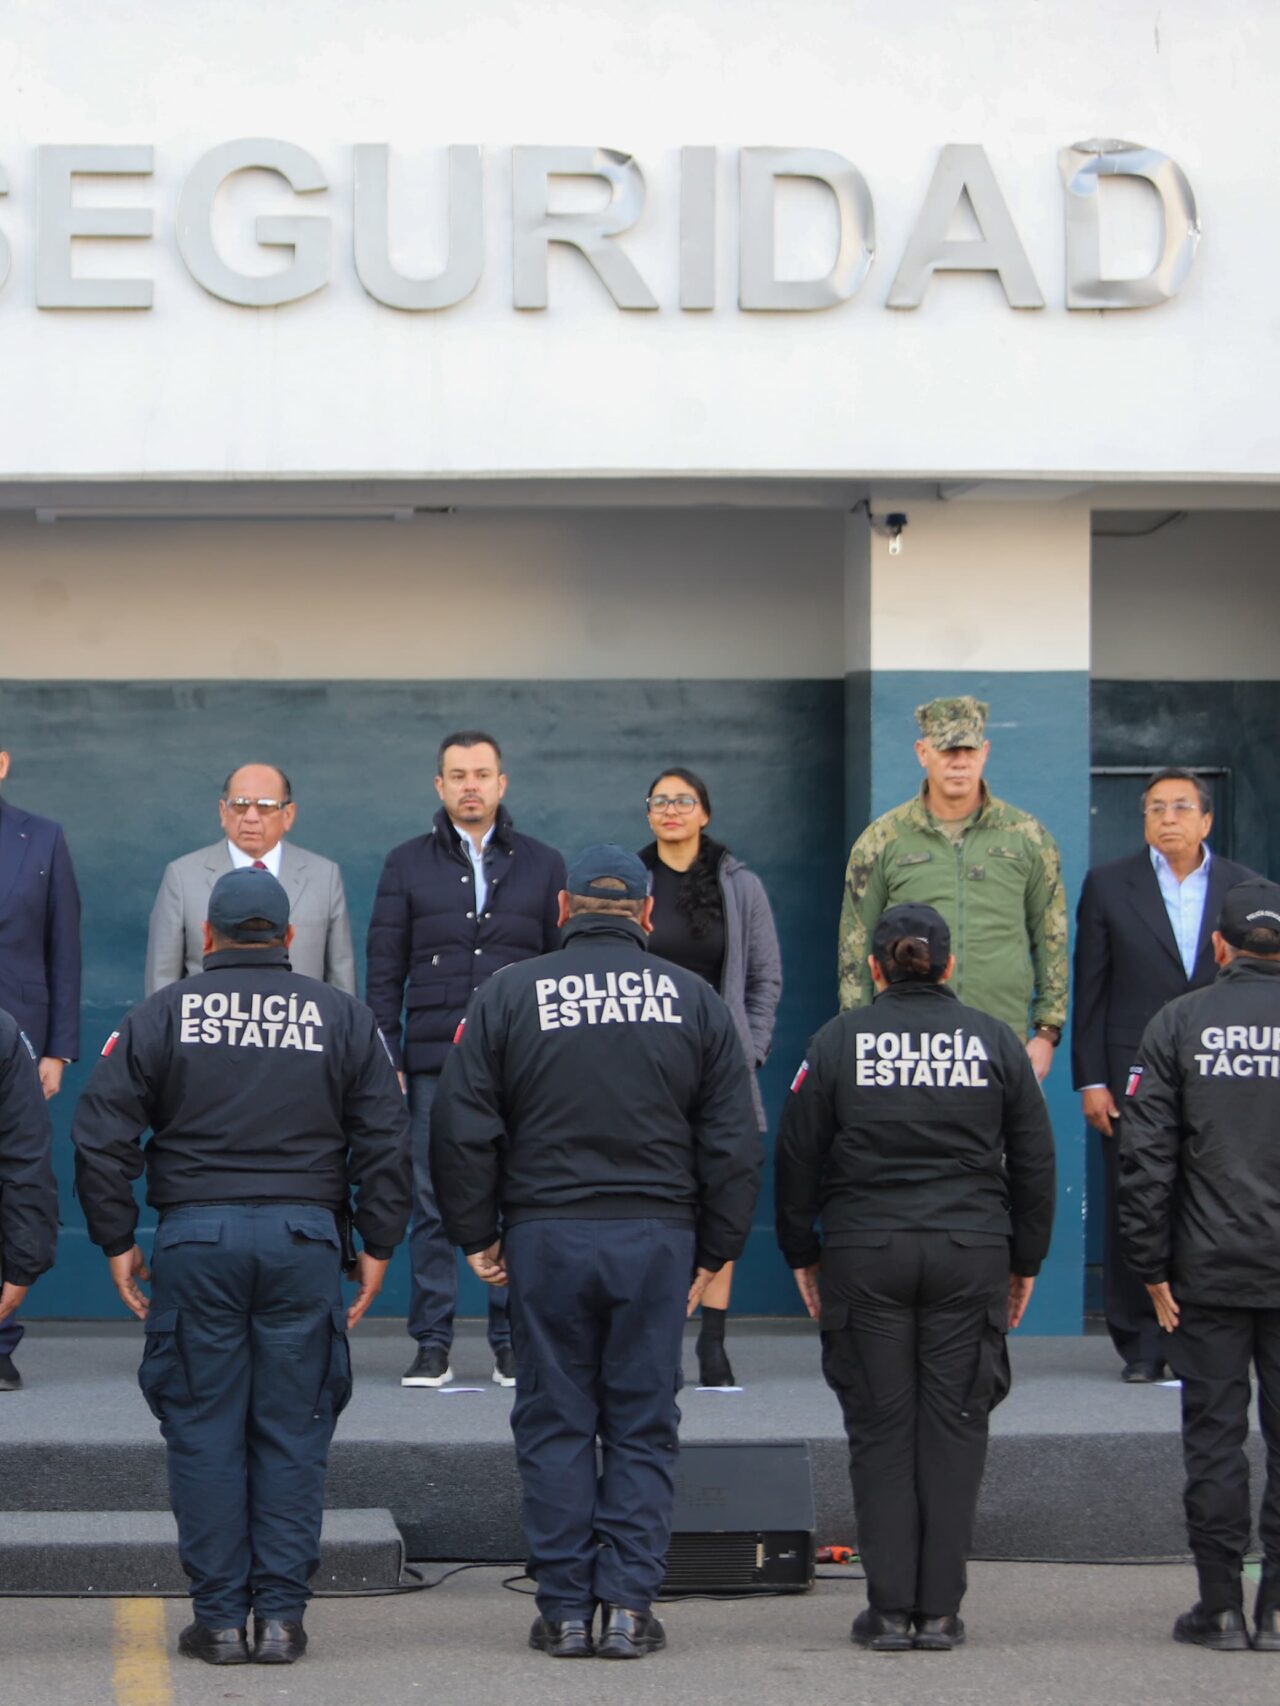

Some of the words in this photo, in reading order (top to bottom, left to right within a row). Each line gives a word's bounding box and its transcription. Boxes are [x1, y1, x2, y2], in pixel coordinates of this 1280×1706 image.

[536, 968, 680, 1005] POLICÍA
[181, 992, 324, 1026] POLICÍA
[538, 996, 683, 1031] ESTATAL
[180, 1018, 324, 1052] ESTATAL
[855, 1028, 989, 1060] POLICÍA
[856, 1060, 989, 1087] ESTATAL
